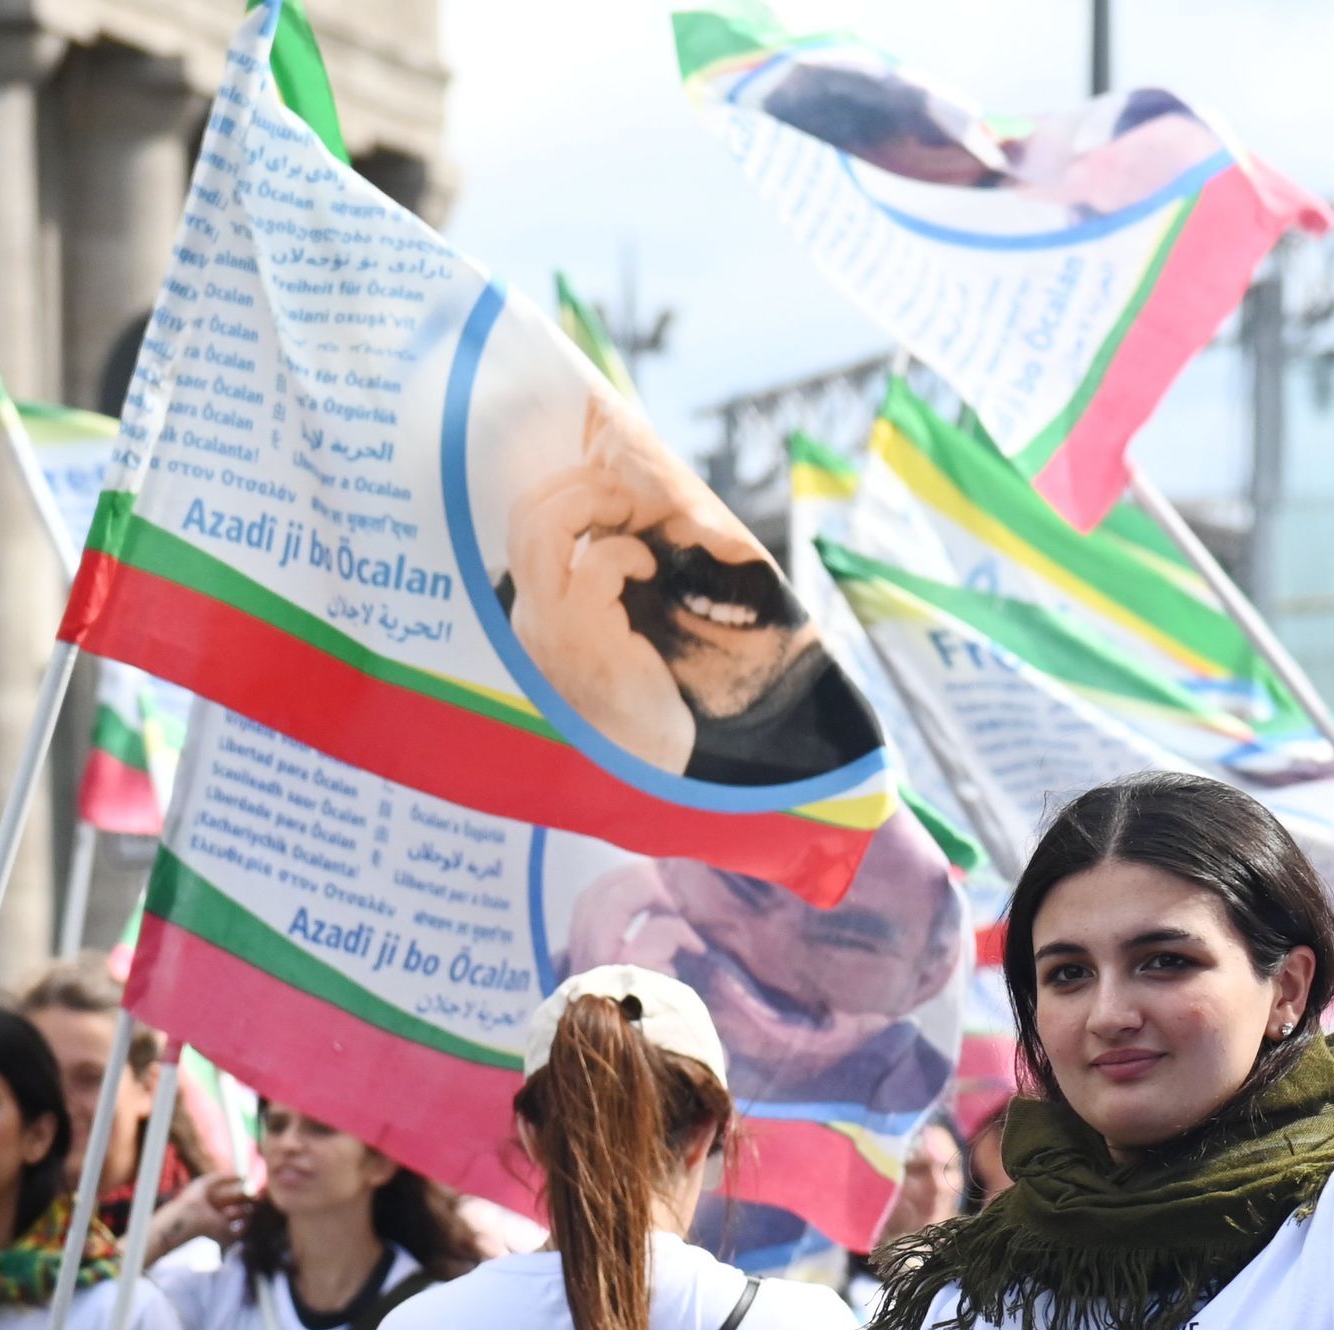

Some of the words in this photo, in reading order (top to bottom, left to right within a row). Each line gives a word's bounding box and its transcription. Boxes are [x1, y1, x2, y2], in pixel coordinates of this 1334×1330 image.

[181, 497, 278, 553] Azadî
[276, 519, 304, 568] ji
[336, 534, 453, 601] Öcalan
[287, 904, 375, 960] Azadî
[371, 929, 402, 973] ji
[402, 938, 441, 978] bo
[447, 942, 532, 994] Öcalan
